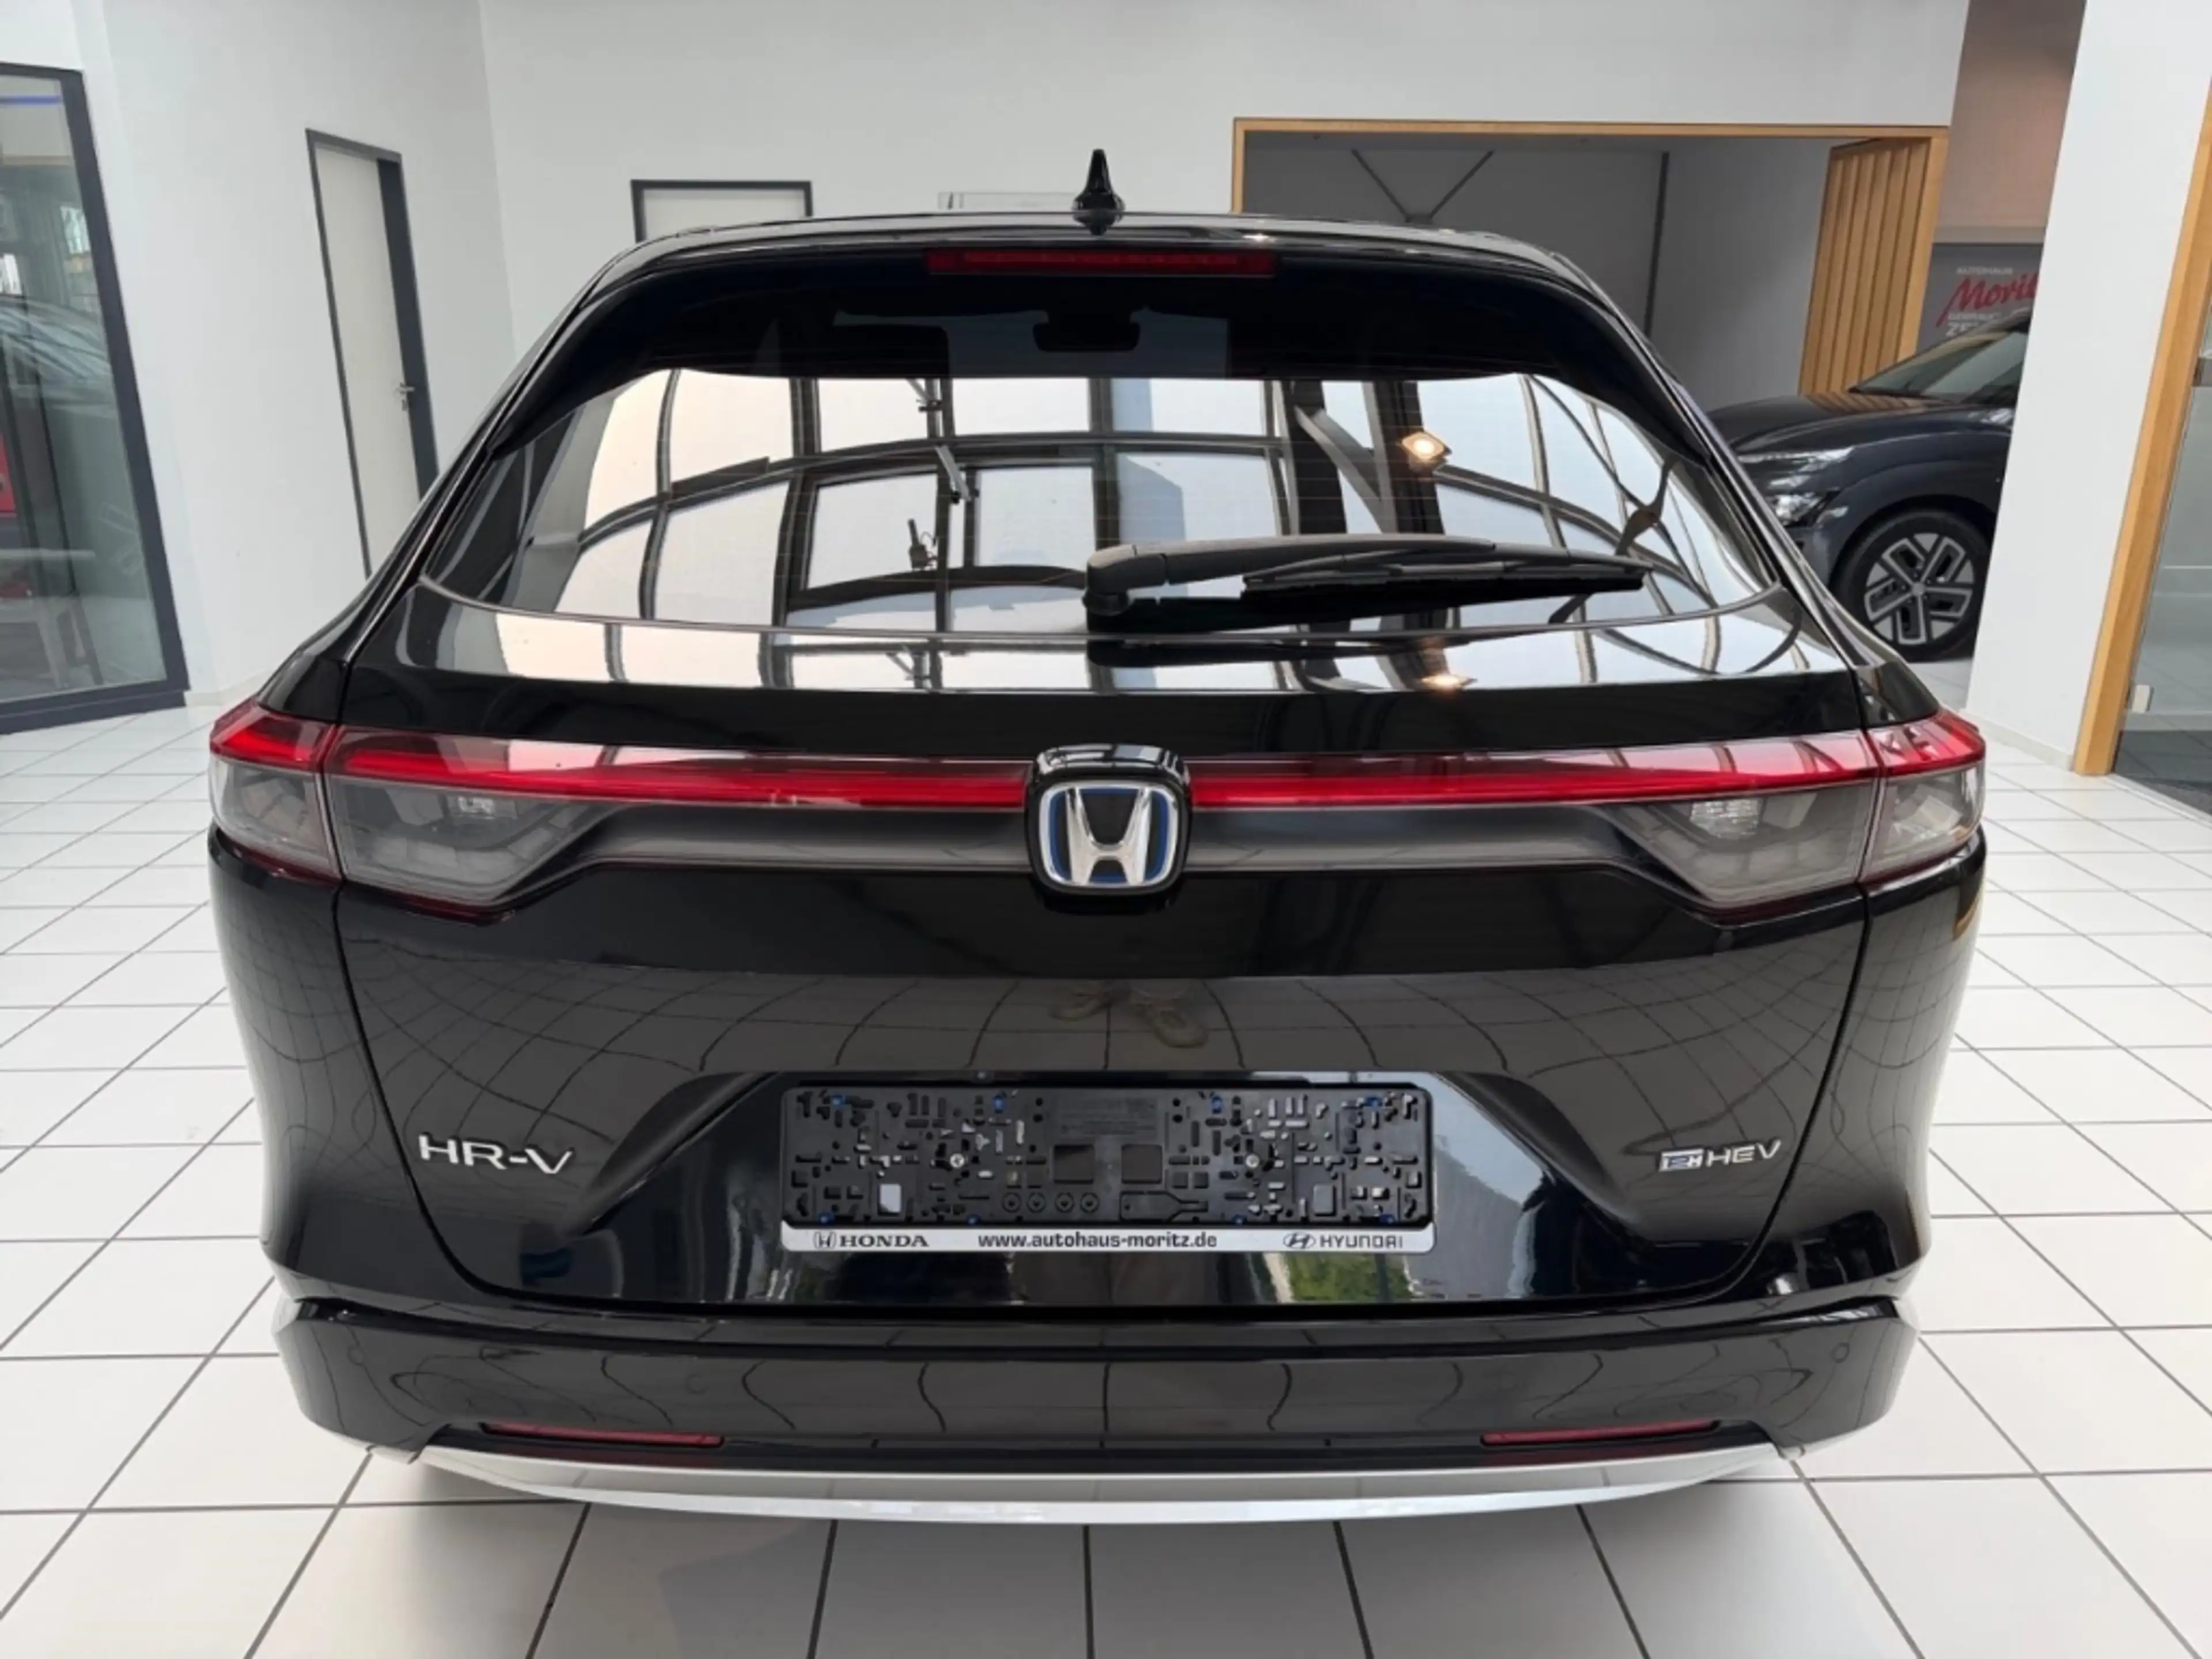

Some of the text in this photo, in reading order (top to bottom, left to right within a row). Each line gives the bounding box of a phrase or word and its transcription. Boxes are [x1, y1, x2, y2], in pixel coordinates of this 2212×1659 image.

[419, 1134, 573, 1174] HR-V
[839, 1234, 929, 1247] HONDA
[978, 1230, 1217, 1248] www.autohaus-moritz.de
[1320, 1234, 1403, 1248] HYUNDAI
